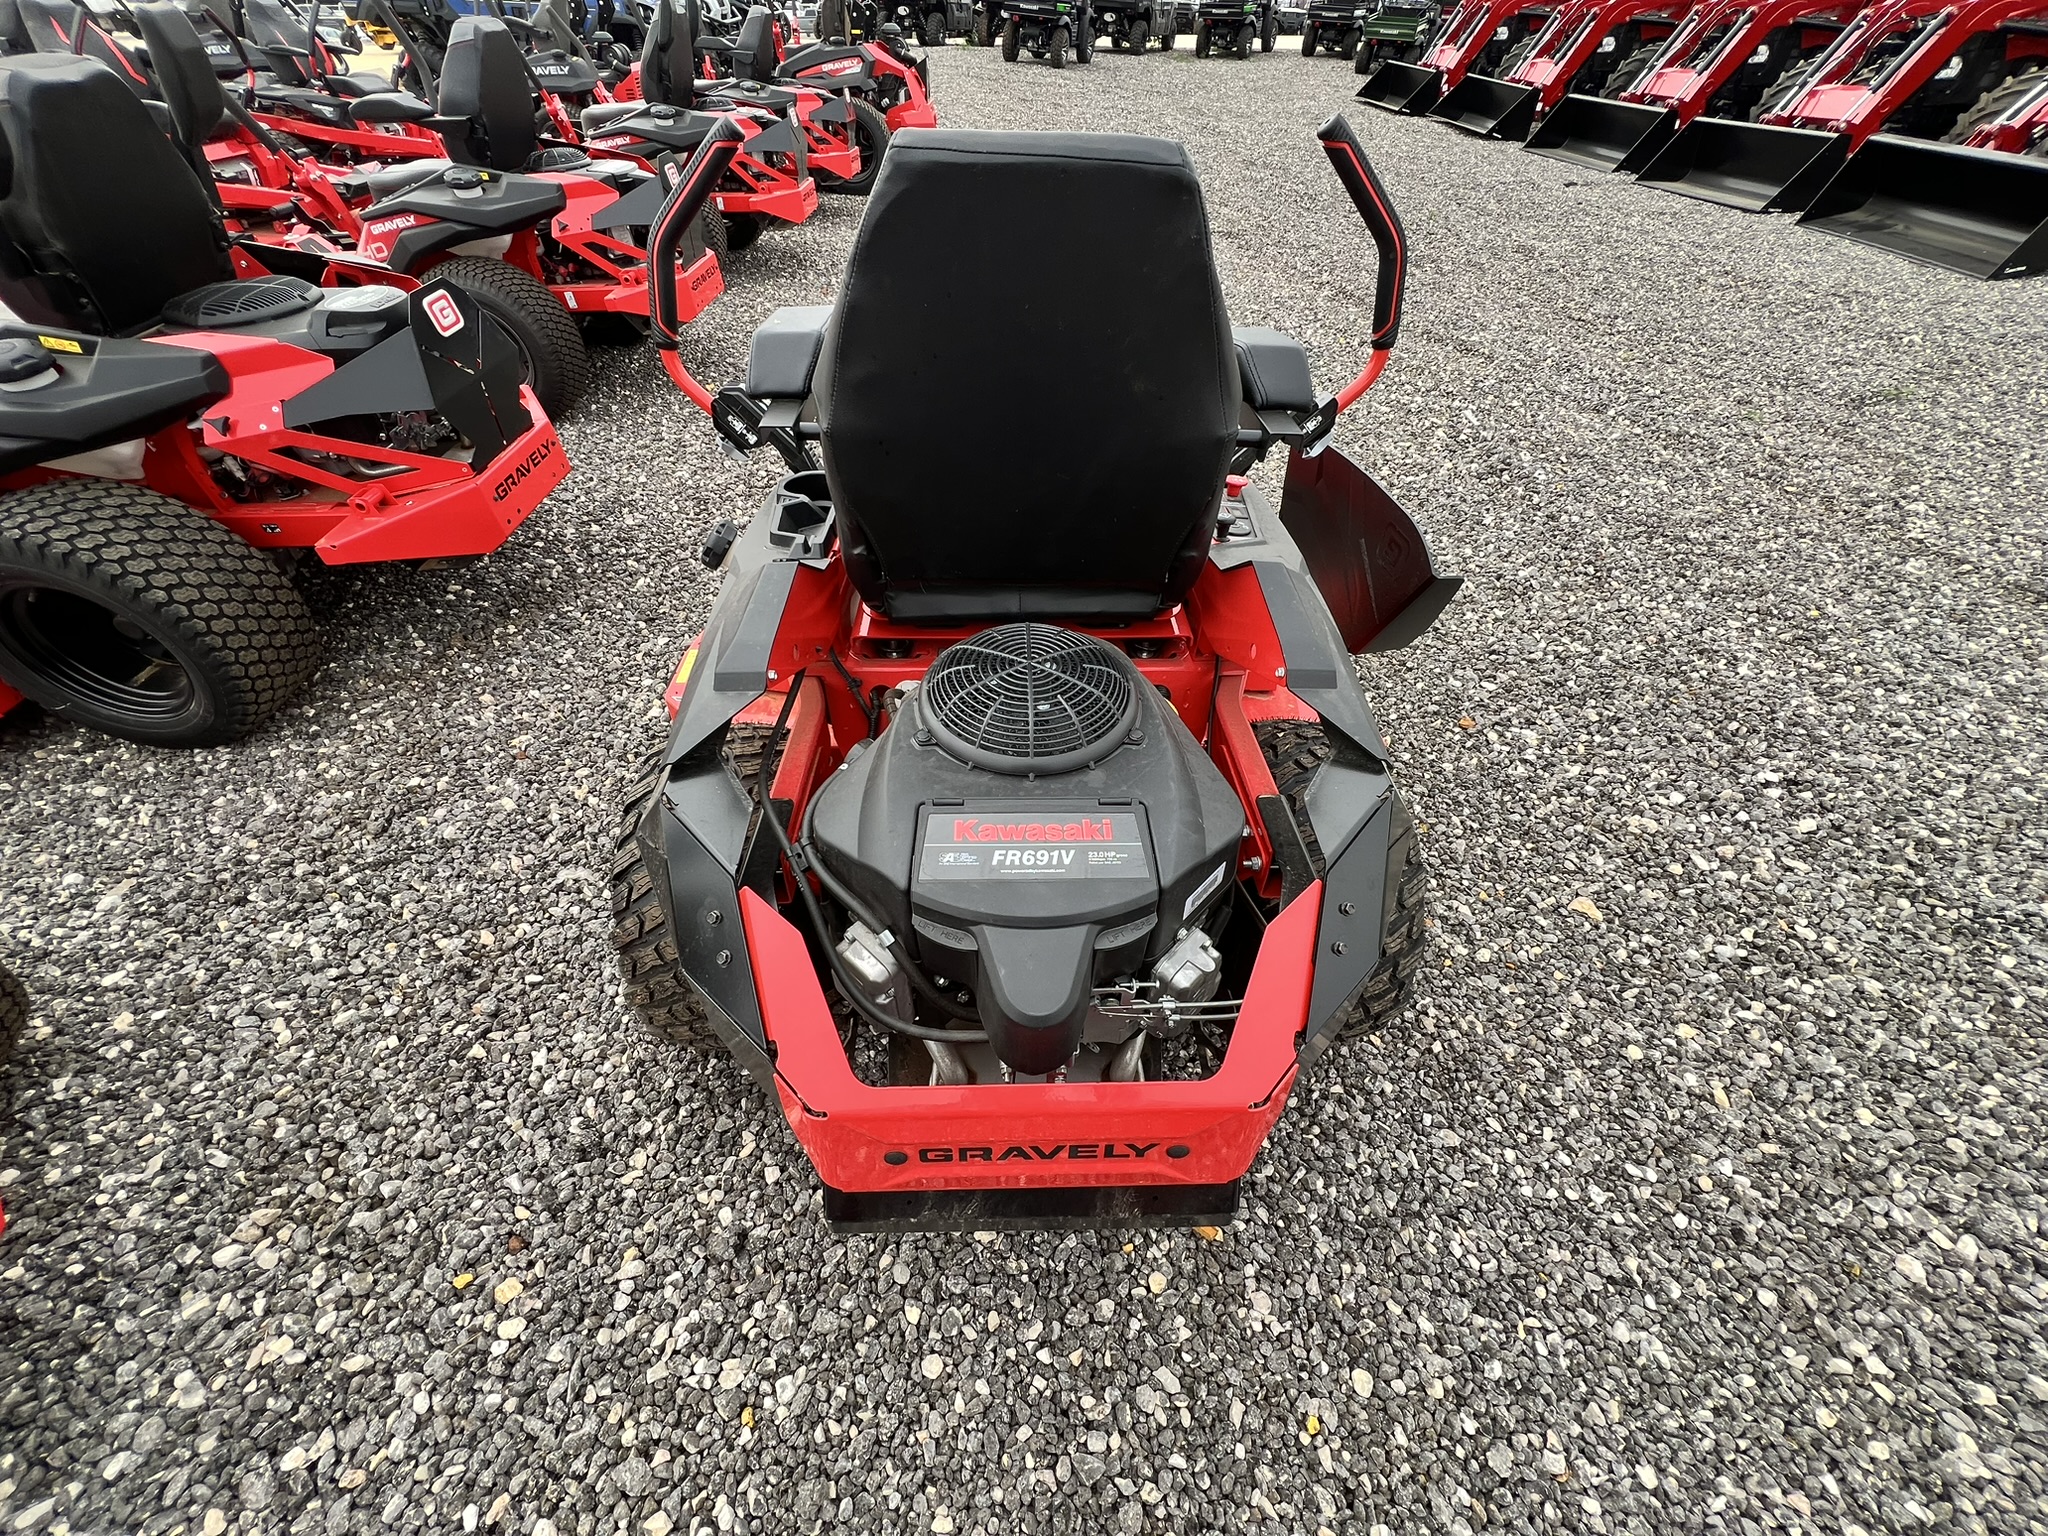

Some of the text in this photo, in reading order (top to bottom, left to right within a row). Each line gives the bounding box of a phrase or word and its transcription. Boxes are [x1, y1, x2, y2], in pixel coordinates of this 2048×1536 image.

[203, 44, 231, 55] VELY
[821, 58, 858, 72] GRAVELY
[370, 214, 416, 235] GRAVELY
[494, 438, 551, 502] GRAVELY
[953, 818, 1114, 842] Kawasaki
[991, 849, 1076, 866] FR691V
[917, 921, 965, 945] LIFT HERE
[1106, 930, 1126, 944] LIFT
[918, 1142, 1161, 1164] GRAVELY
